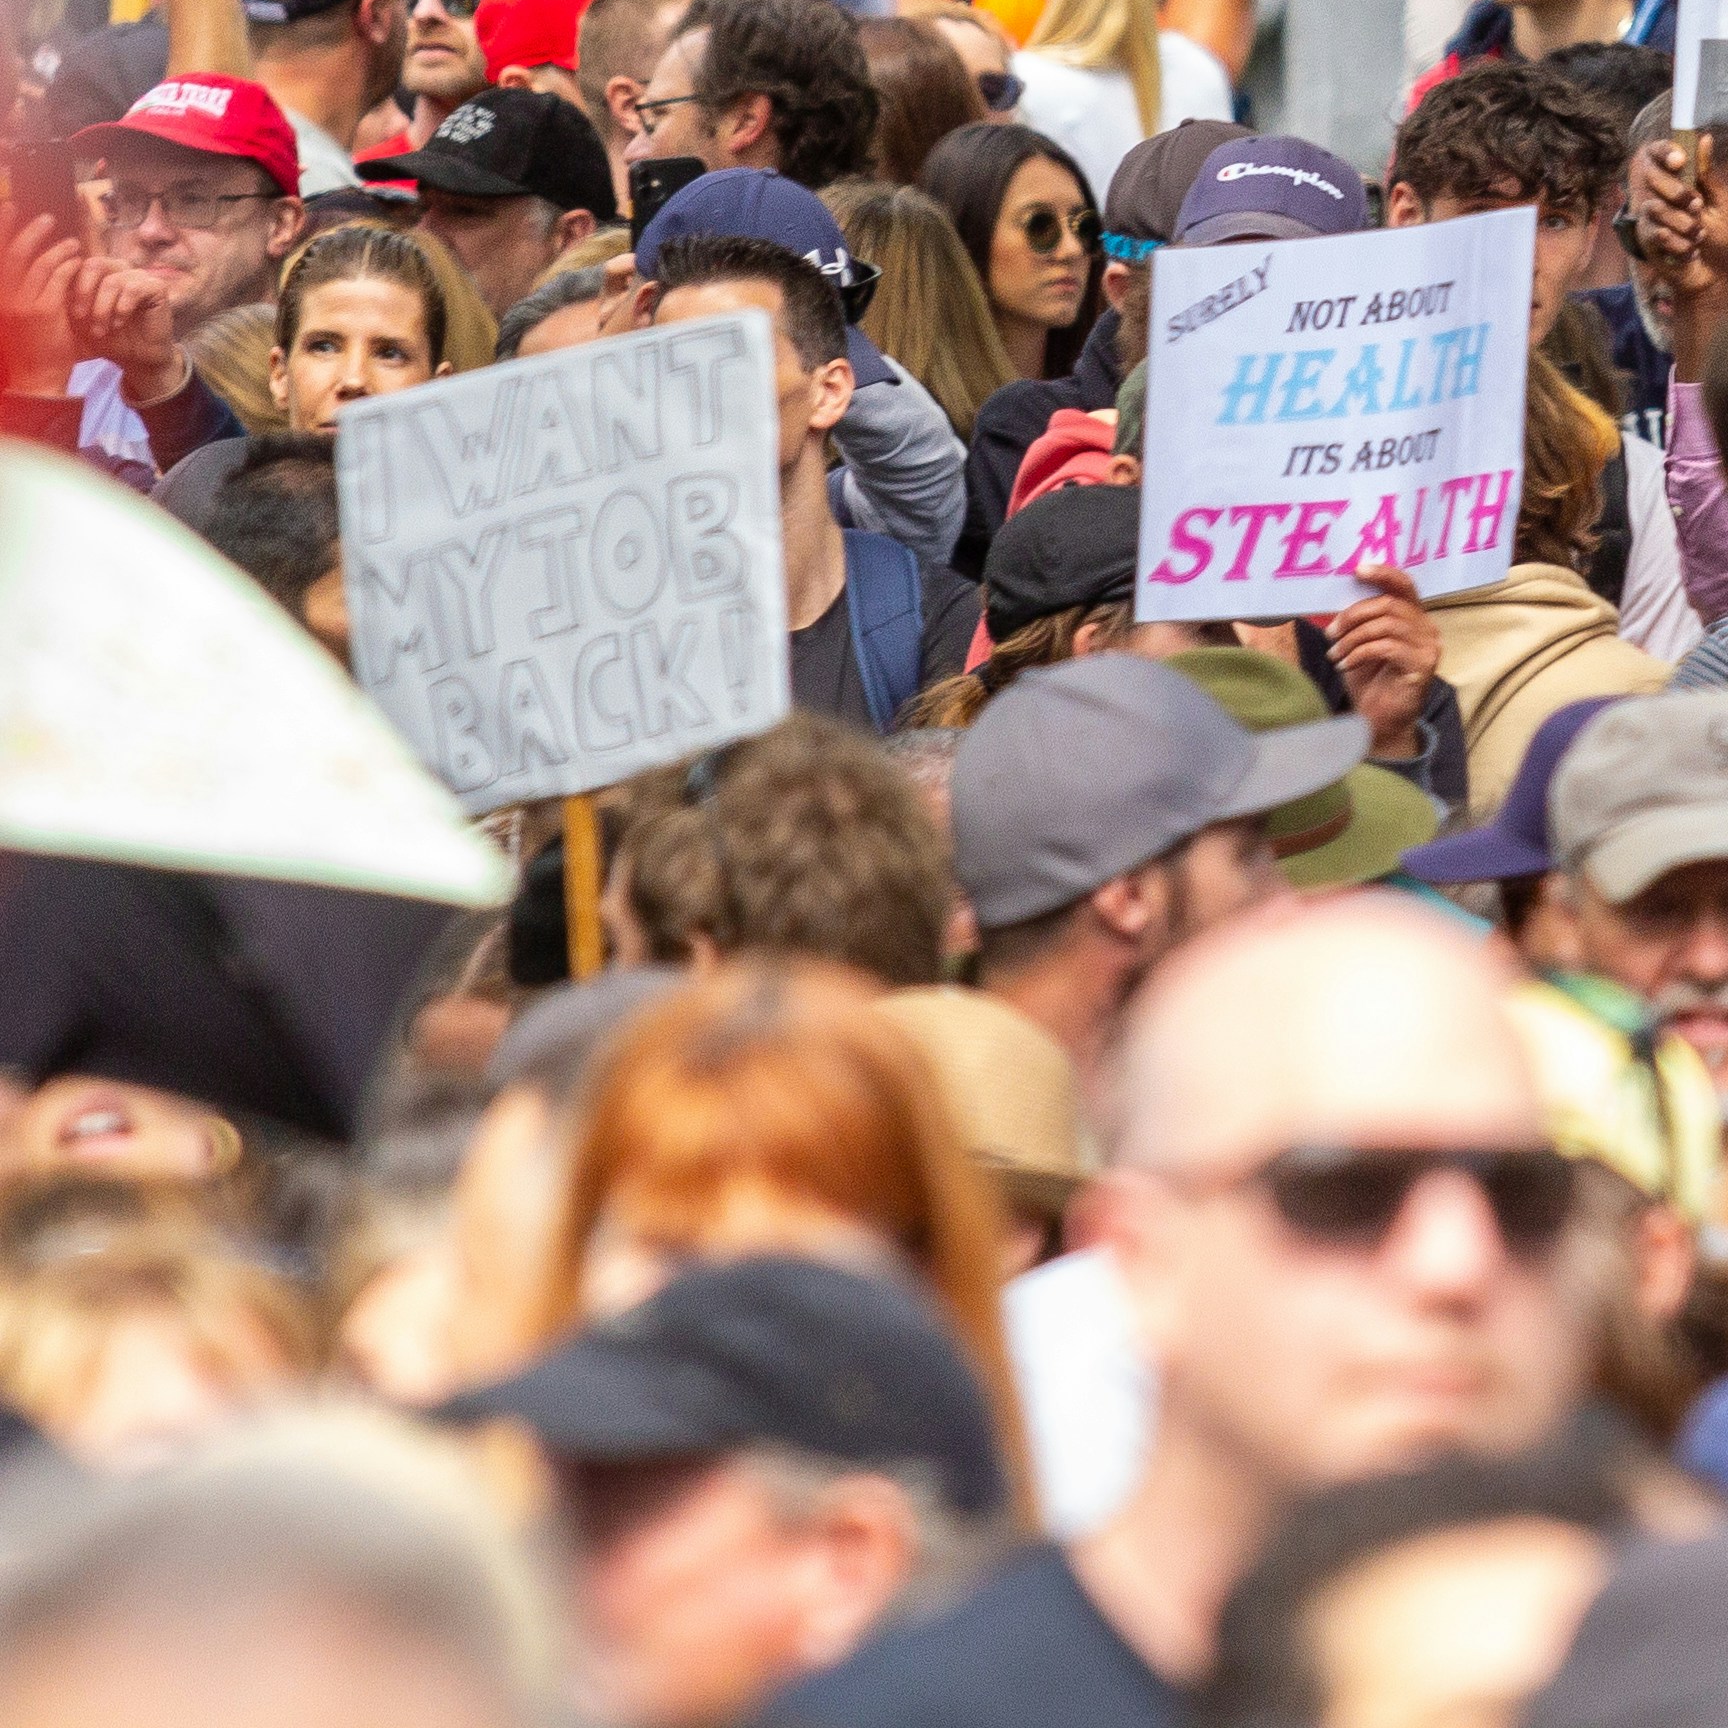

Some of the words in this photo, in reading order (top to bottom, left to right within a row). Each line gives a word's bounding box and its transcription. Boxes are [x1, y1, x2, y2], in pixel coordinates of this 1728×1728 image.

[1216, 160, 1345, 201] Champion
[1165, 252, 1274, 344] SURELY
[1285, 295, 1358, 334] NOT
[1359, 280, 1456, 325] ABOUT
[1215, 321, 1495, 426] HEALTH
[354, 411, 398, 546] I
[412, 322, 747, 520] WANT
[1280, 440, 1344, 478] ITS
[1349, 428, 1442, 474] ABOUT
[1148, 468, 1516, 585] STEALTH
[358, 524, 507, 688] MY
[515, 475, 750, 641] JOB
[424, 600, 756, 796] BACK!
